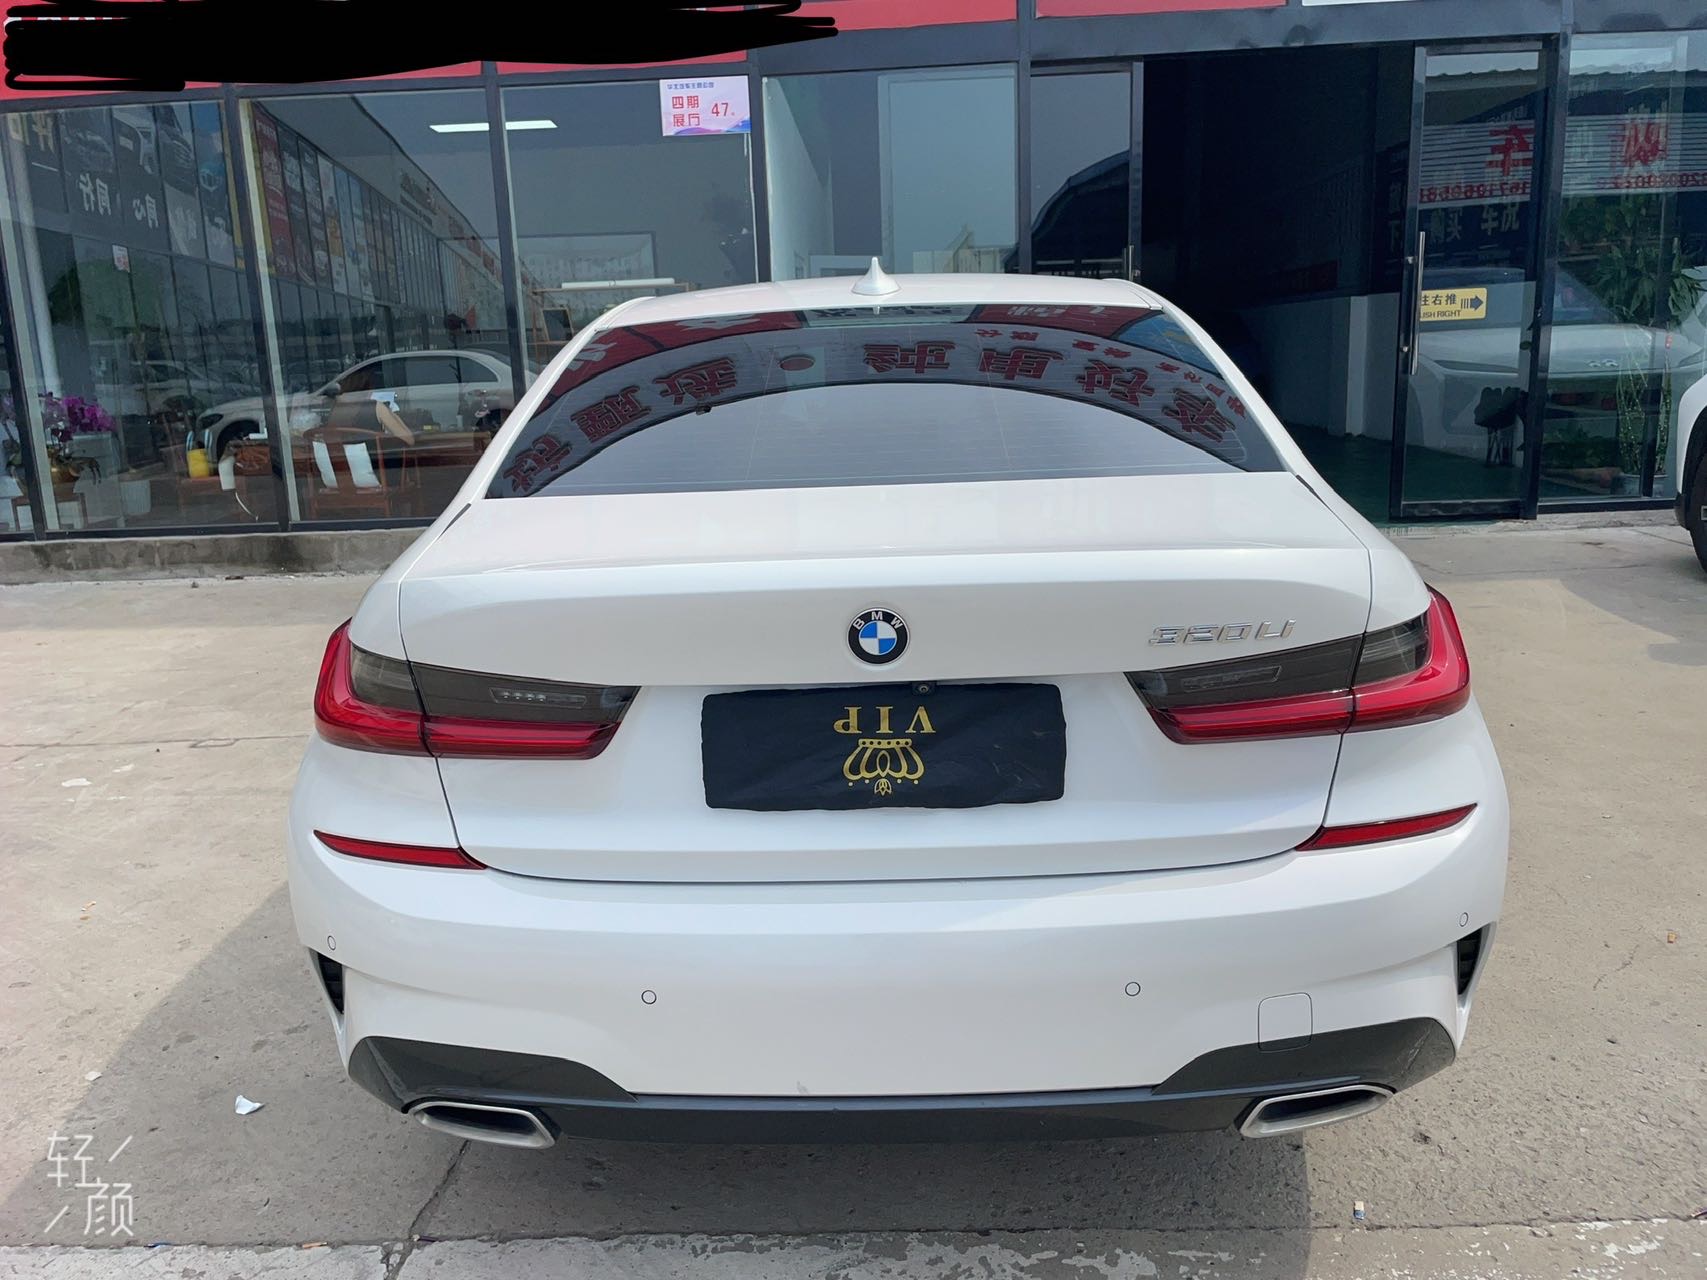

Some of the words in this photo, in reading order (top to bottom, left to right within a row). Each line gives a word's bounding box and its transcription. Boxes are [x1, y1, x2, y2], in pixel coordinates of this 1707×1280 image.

[672, 95, 700, 109] 四期
[673, 113, 700, 127] 展厅
[1437, 309, 1461, 318] RIGHT
[852, 610, 904, 631] BMW
[833, 705, 936, 734] VIP
